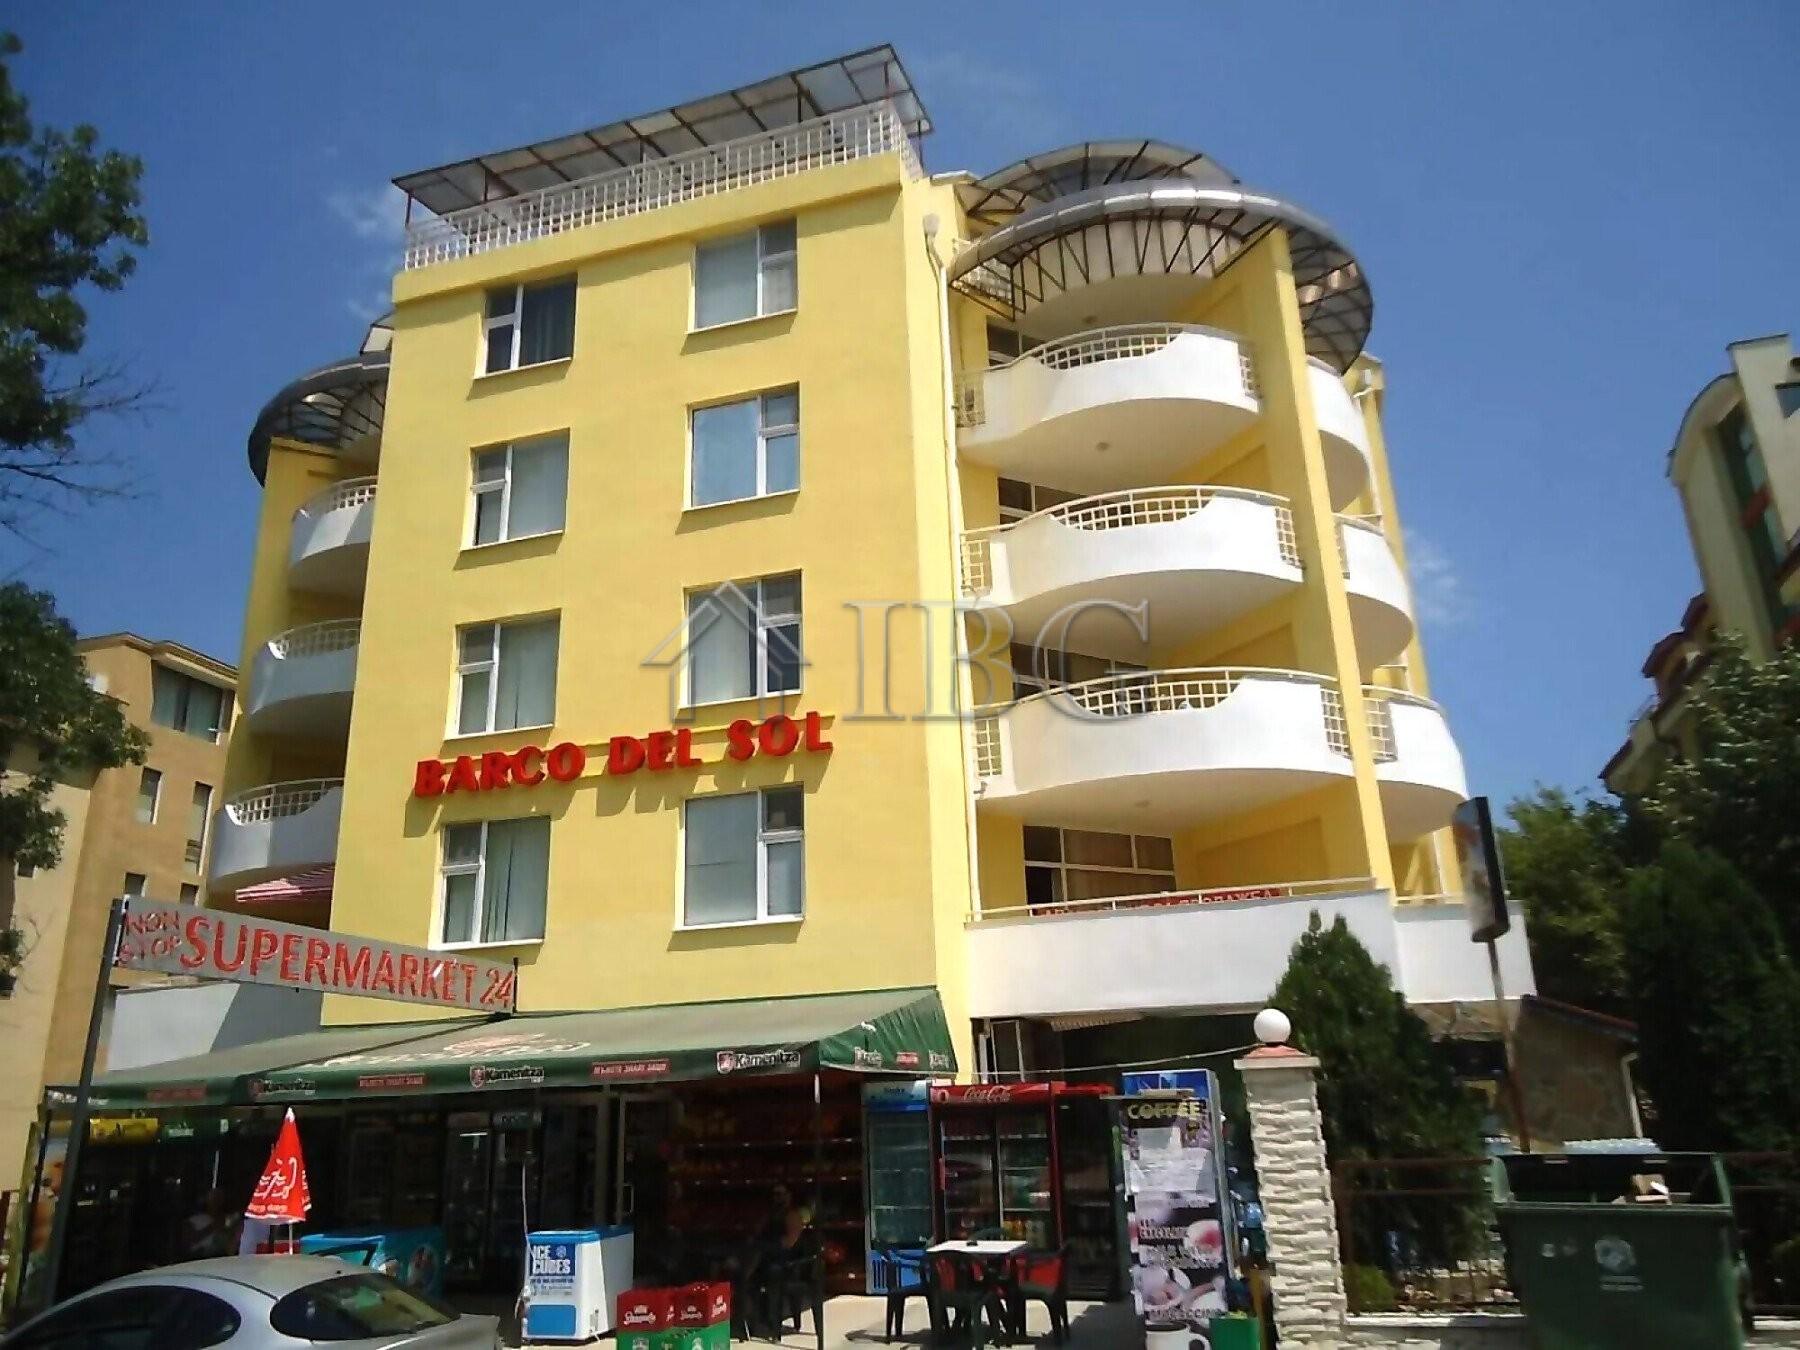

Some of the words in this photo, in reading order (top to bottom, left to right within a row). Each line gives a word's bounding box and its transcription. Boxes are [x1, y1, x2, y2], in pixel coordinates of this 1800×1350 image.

[414, 743, 585, 797] BARCO
[607, 727, 702, 774] DEL
[726, 711, 833, 761] SOL
[124, 910, 180, 936] NON
[119, 936, 182, 964] STOP
[180, 914, 477, 1003] SUPERMARKET
[480, 967, 513, 1008] 24
[735, 1050, 800, 1070] Kamenitza
[1128, 1101, 1200, 1119] COFFEE
